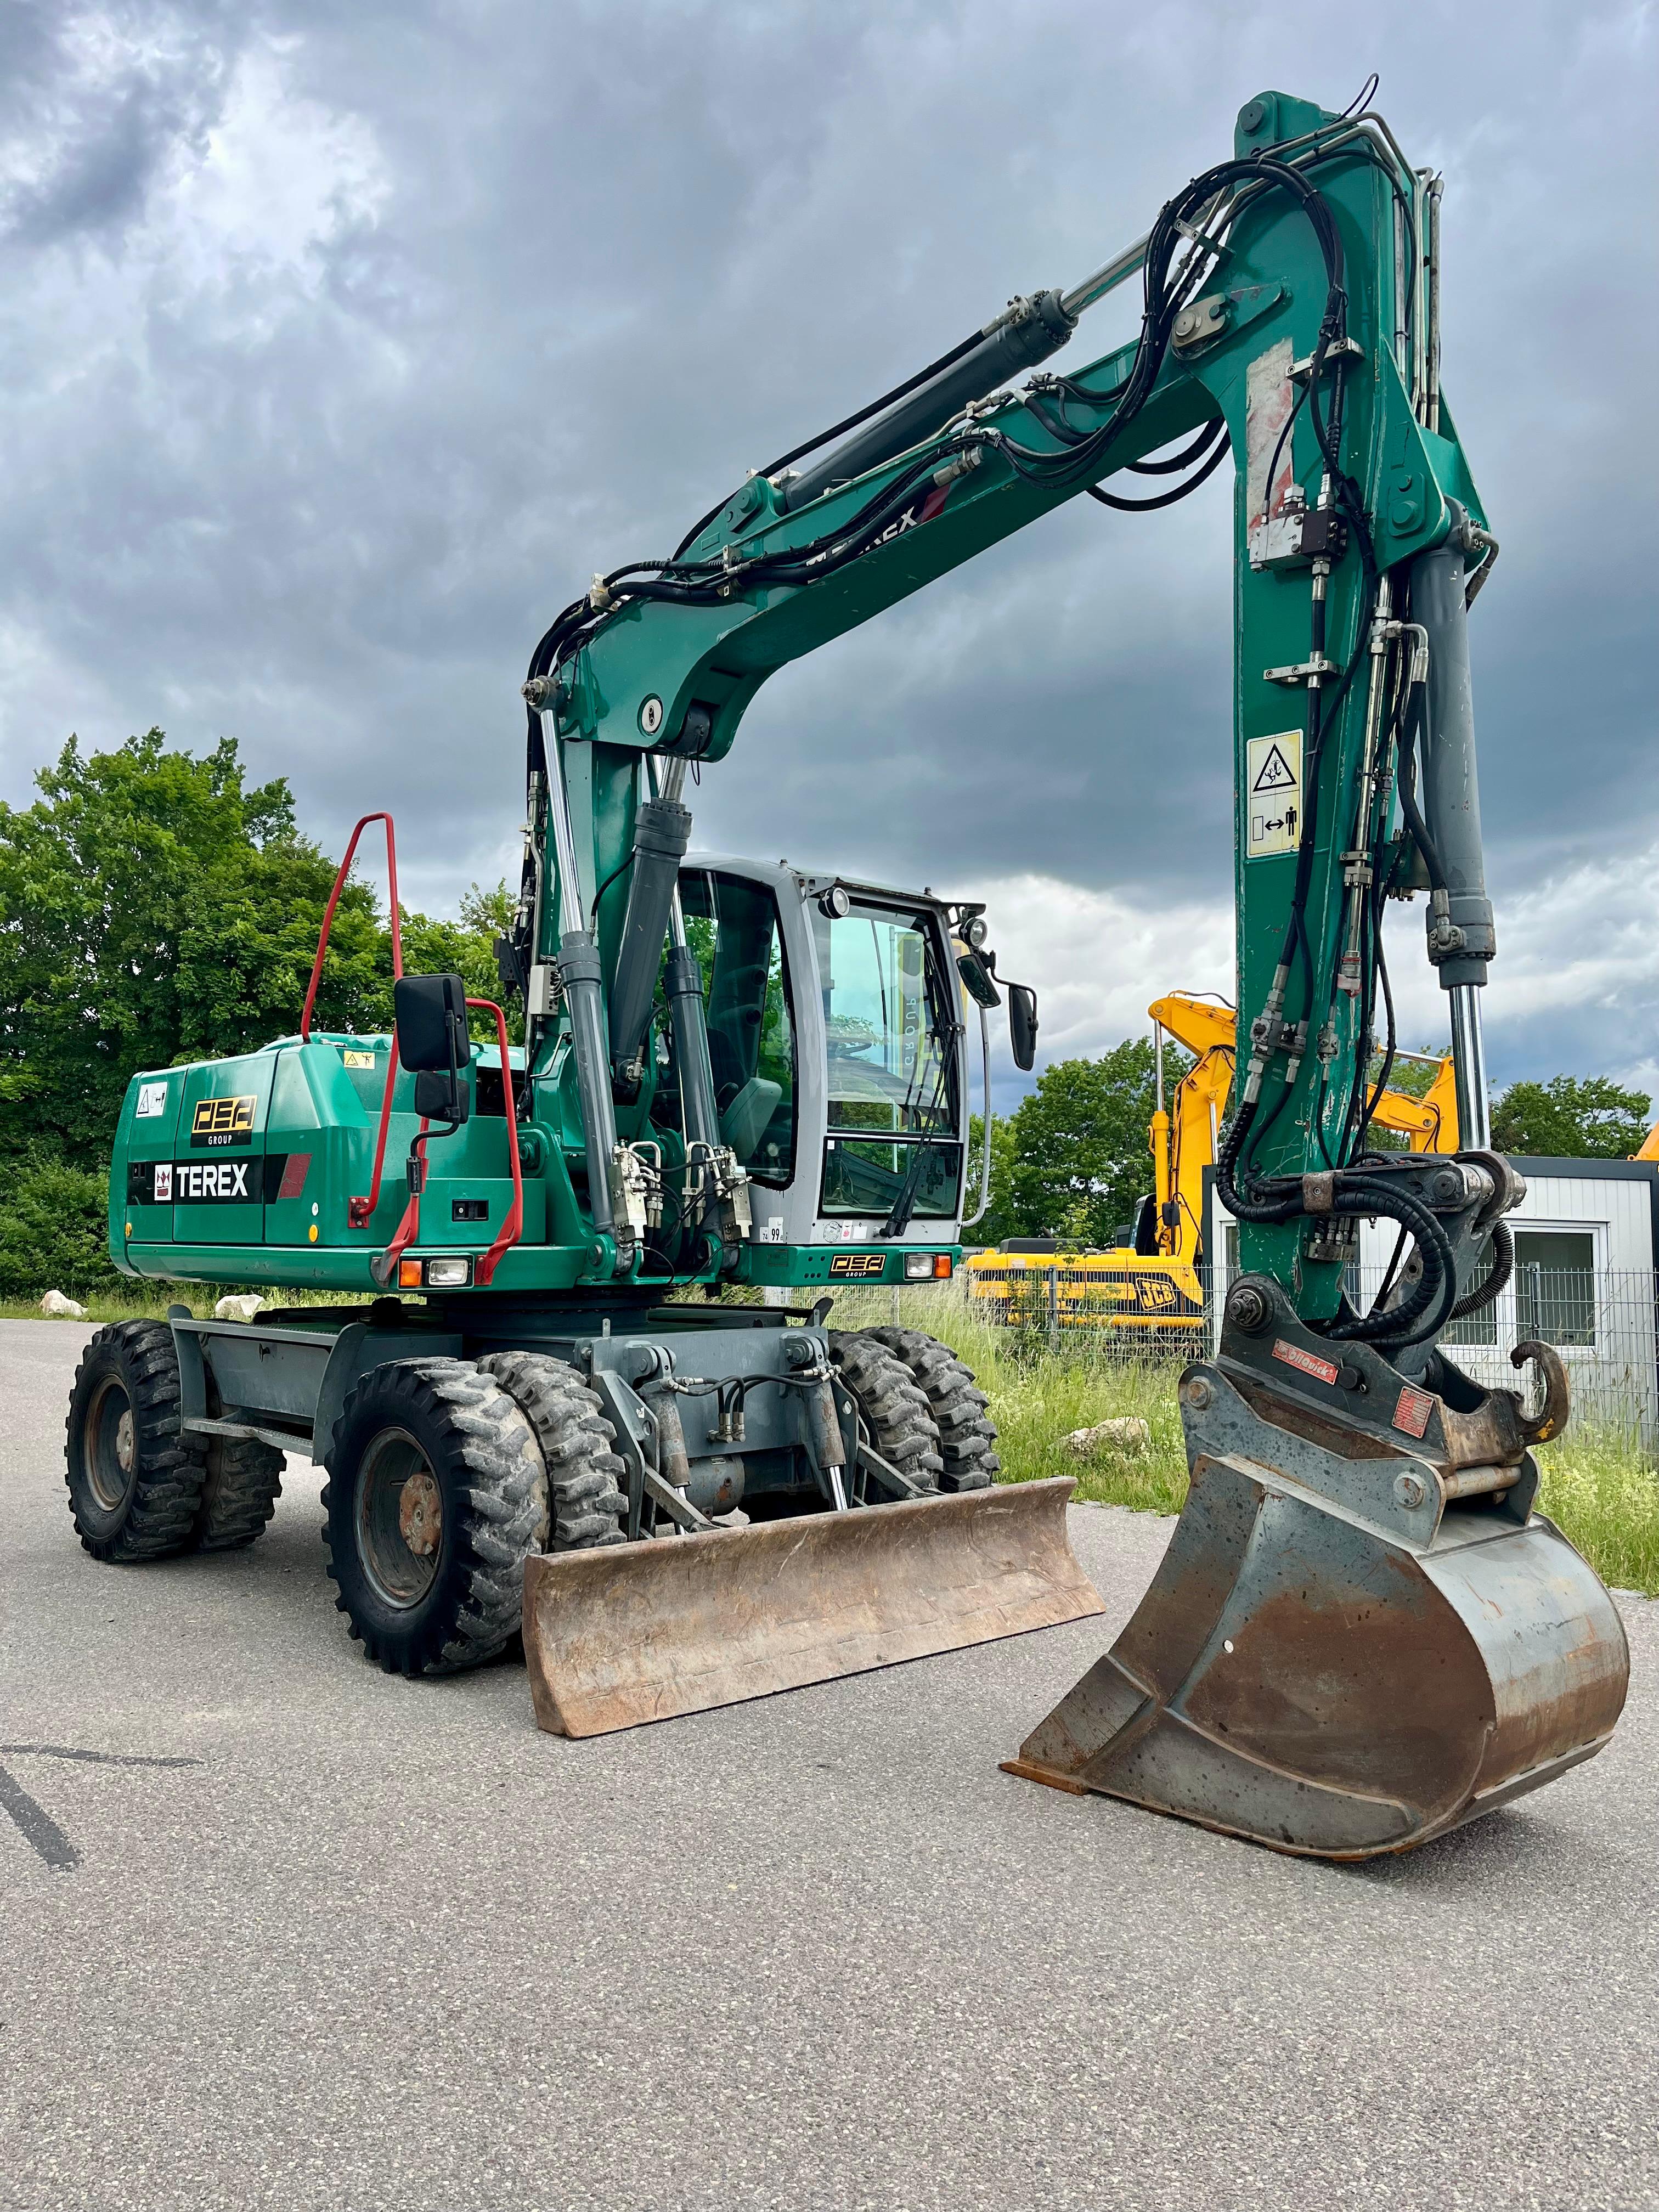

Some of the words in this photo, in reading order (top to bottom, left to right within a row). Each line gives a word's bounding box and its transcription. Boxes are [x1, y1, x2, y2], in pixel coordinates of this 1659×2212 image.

[208, 1135, 232, 1145] GROUP
[176, 1164, 249, 1197] TEREX
[771, 1228, 780, 1241] 99
[1142, 1281, 1172, 1307] JCB
